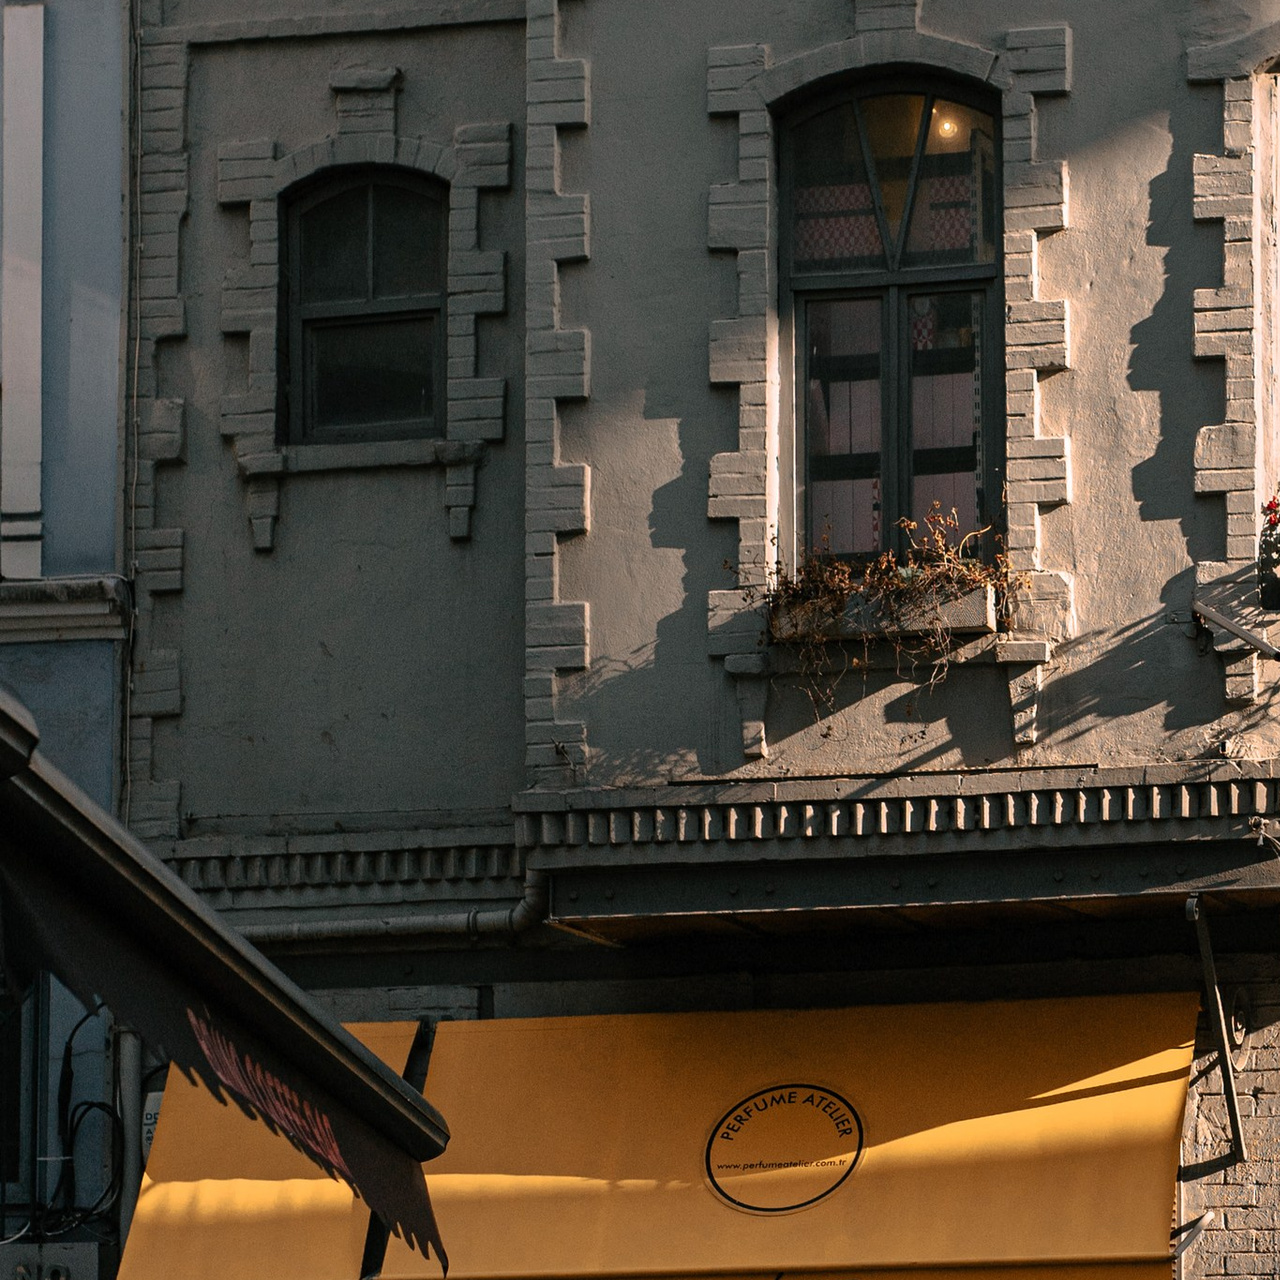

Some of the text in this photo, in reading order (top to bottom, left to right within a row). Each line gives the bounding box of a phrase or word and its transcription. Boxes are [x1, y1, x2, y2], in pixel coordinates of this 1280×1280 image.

[720, 1092, 852, 1141] PERFUME ATELIER
[717, 1159, 847, 1171] www.perfumeatelier.com.tr
